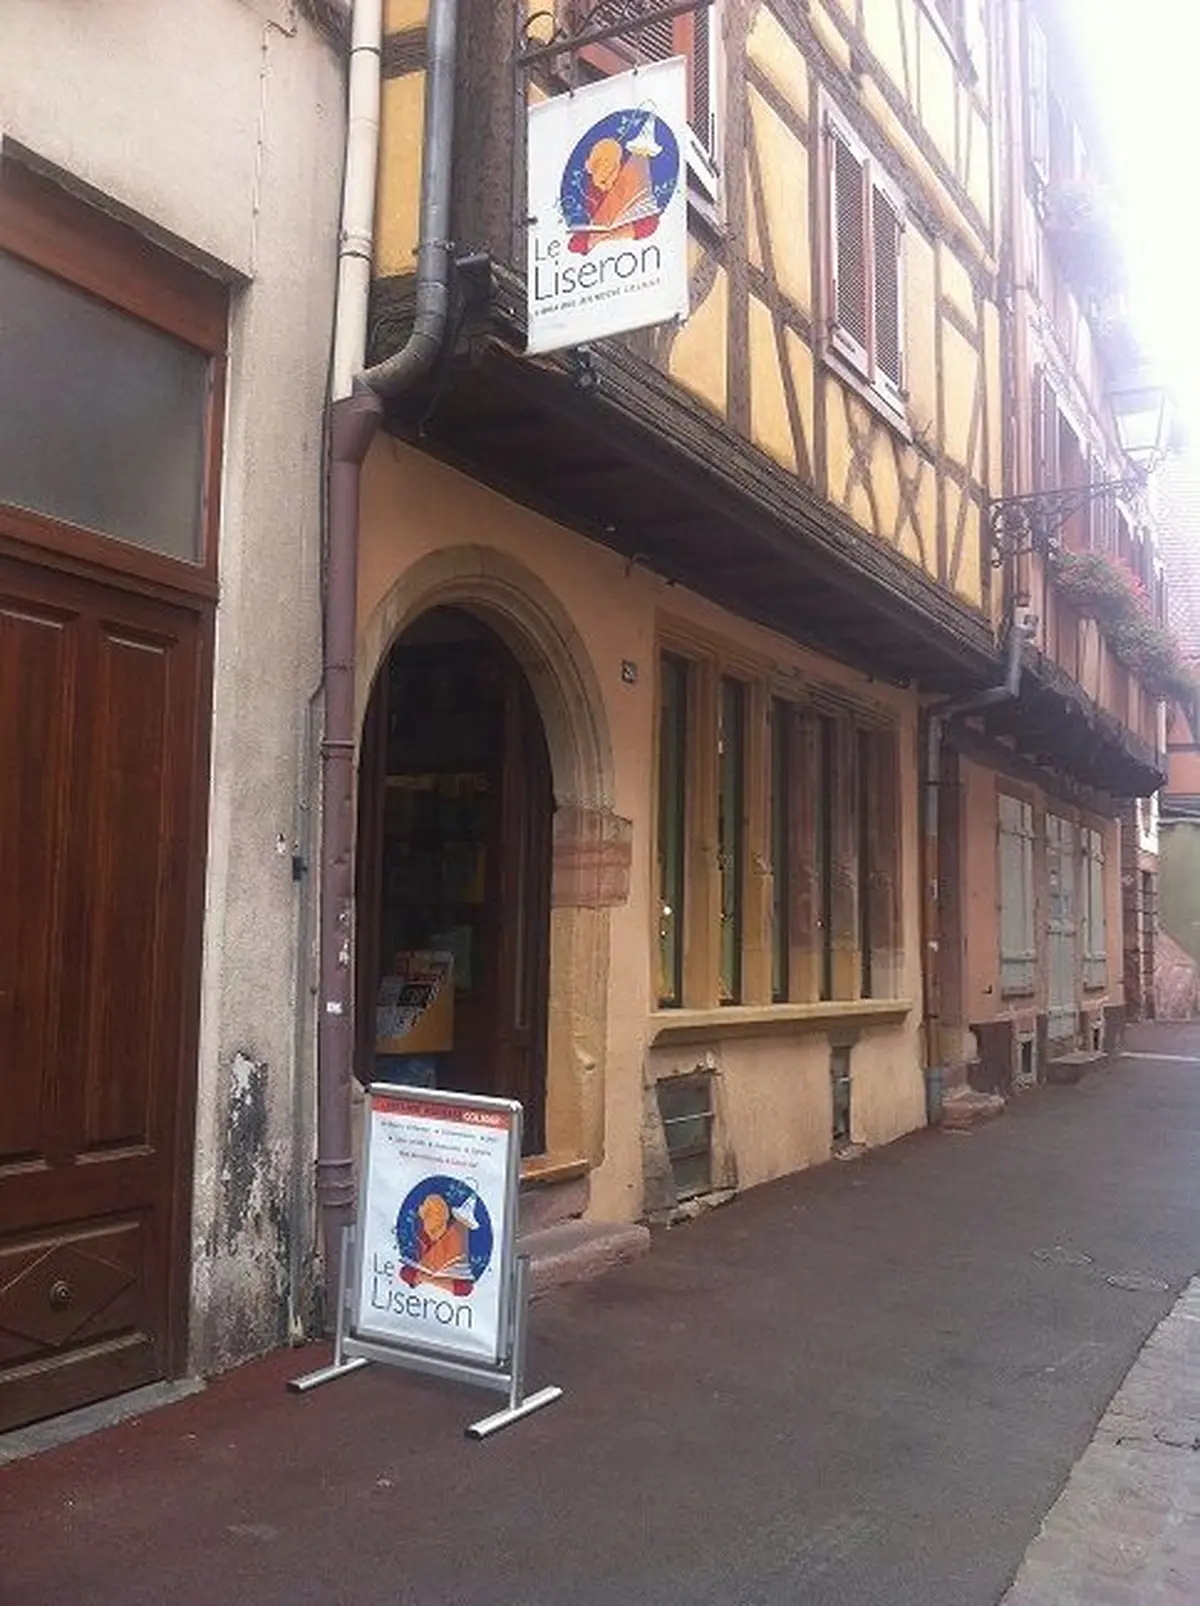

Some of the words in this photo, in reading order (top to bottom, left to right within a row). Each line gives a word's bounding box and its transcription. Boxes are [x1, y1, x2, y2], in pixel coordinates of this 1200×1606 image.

[535, 238, 561, 261] Le
[535, 245, 660, 301] Liseron
[374, 1252, 395, 1277] Le
[371, 1276, 472, 1329] Liseron
